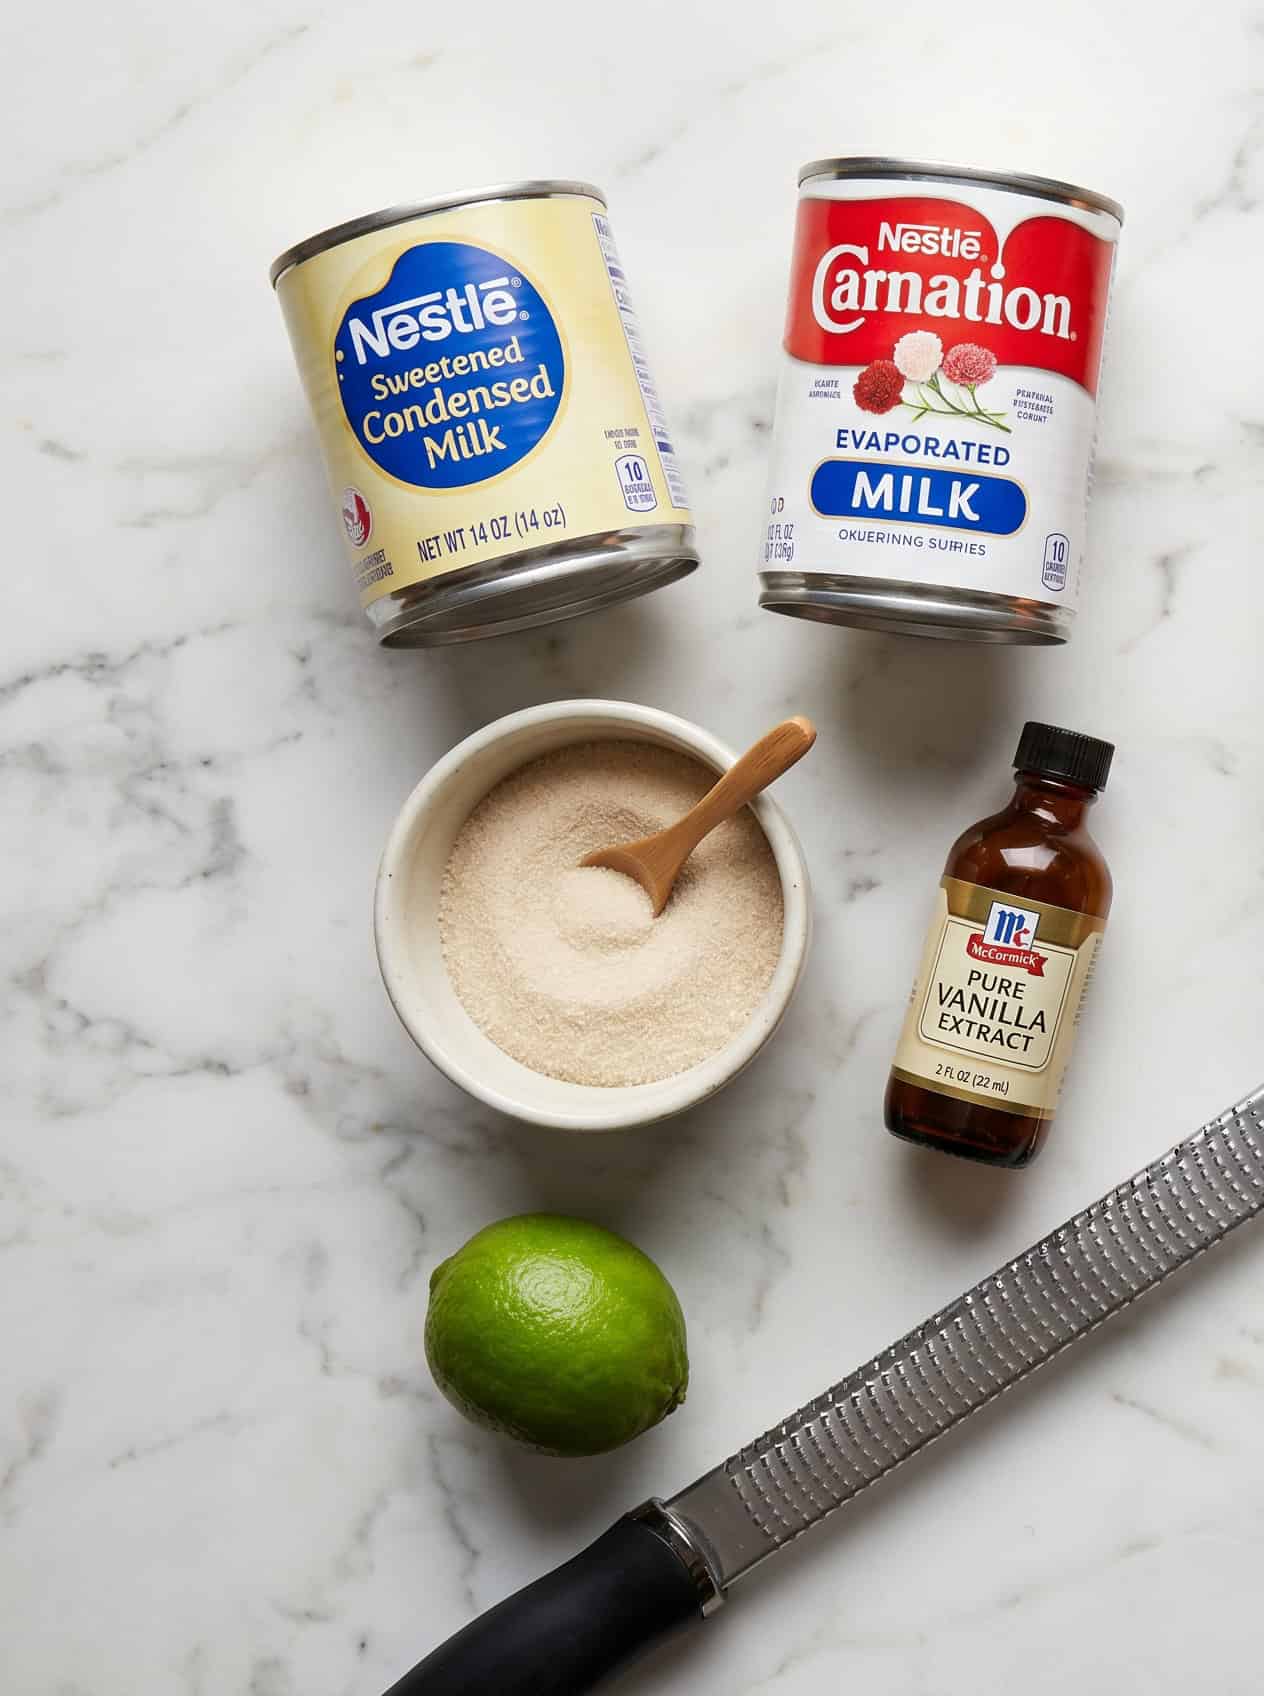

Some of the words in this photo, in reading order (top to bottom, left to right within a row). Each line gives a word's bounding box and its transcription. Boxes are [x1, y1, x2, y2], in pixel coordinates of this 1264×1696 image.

[812, 243, 1072, 340] Carnation
[370, 335, 525, 401] Sweetened
[362, 364, 555, 444] Condensed
[423, 418, 507, 469] Milk
[836, 428, 1011, 466] EVAPORATED
[624, 461, 642, 482] 10
[851, 471, 980, 522] MILK
[416, 535, 443, 564] NET
[443, 528, 467, 553] WT
[469, 522, 488, 547] 14
[490, 515, 512, 541] OZ
[514, 508, 540, 539] (14
[543, 503, 568, 529] oz)
[1053, 541, 1065, 562] 10
[971, 941, 1038, 968] McCormick
[967, 969, 1027, 1000] PURE
[938, 982, 1047, 1034] VANILLA
[938, 1012, 1035, 1053] EXTRACT
[935, 1063, 943, 1076] 2
[957, 1070, 971, 1084] OZ
[972, 1073, 991, 1090] (22
